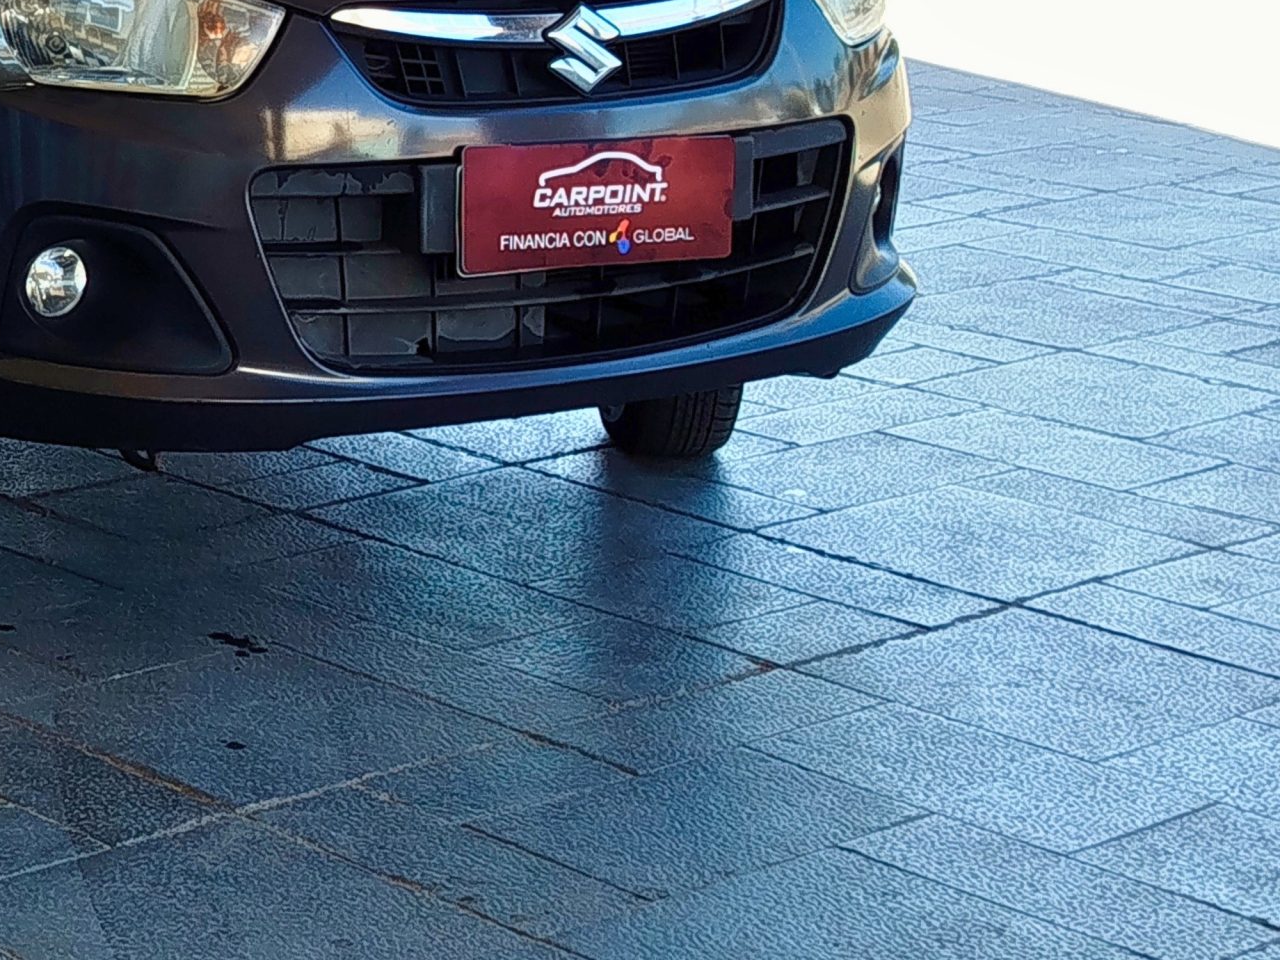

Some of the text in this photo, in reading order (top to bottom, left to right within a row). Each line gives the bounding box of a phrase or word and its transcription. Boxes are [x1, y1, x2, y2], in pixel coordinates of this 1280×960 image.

[552, 203, 642, 218] AUTOMOTORES
[500, 227, 695, 251] FINANCIA CON GLOBAL
